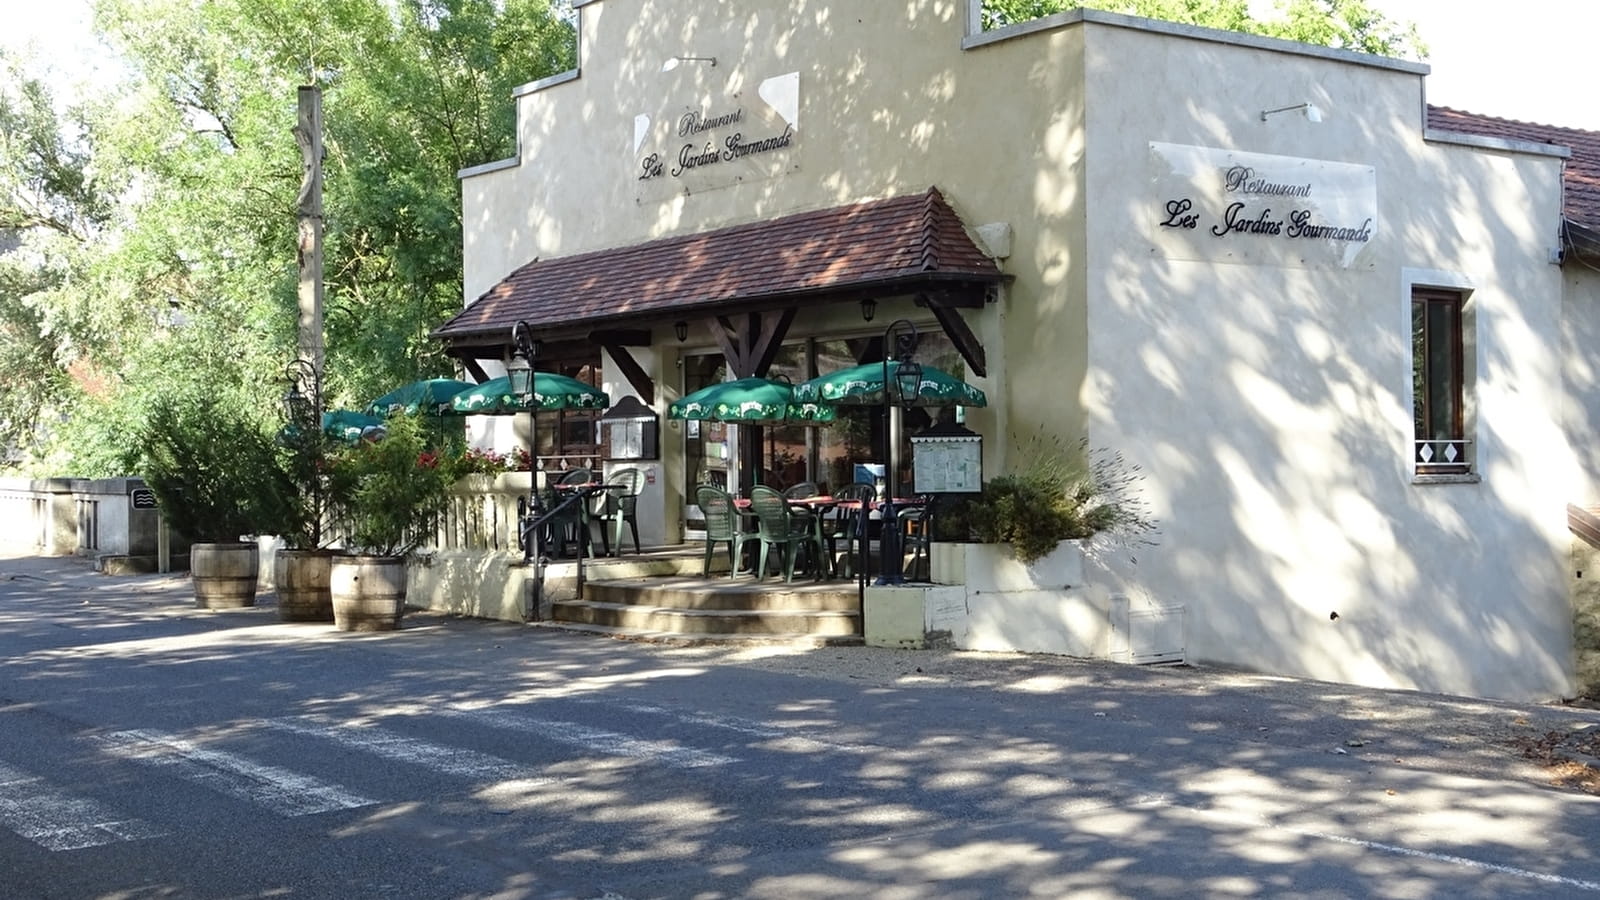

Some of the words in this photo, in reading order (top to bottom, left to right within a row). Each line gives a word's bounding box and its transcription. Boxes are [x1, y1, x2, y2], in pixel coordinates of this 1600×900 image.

[679, 109, 742, 137] Restaurant
[638, 152, 663, 181] Les
[671, 143, 720, 177] Jardins
[723, 123, 793, 162] Gourmands
[1225, 166, 1312, 198] Restaurant
[1159, 198, 1200, 230] Les
[1211, 202, 1283, 236] Jardins
[1287, 210, 1372, 243] Gourmands
